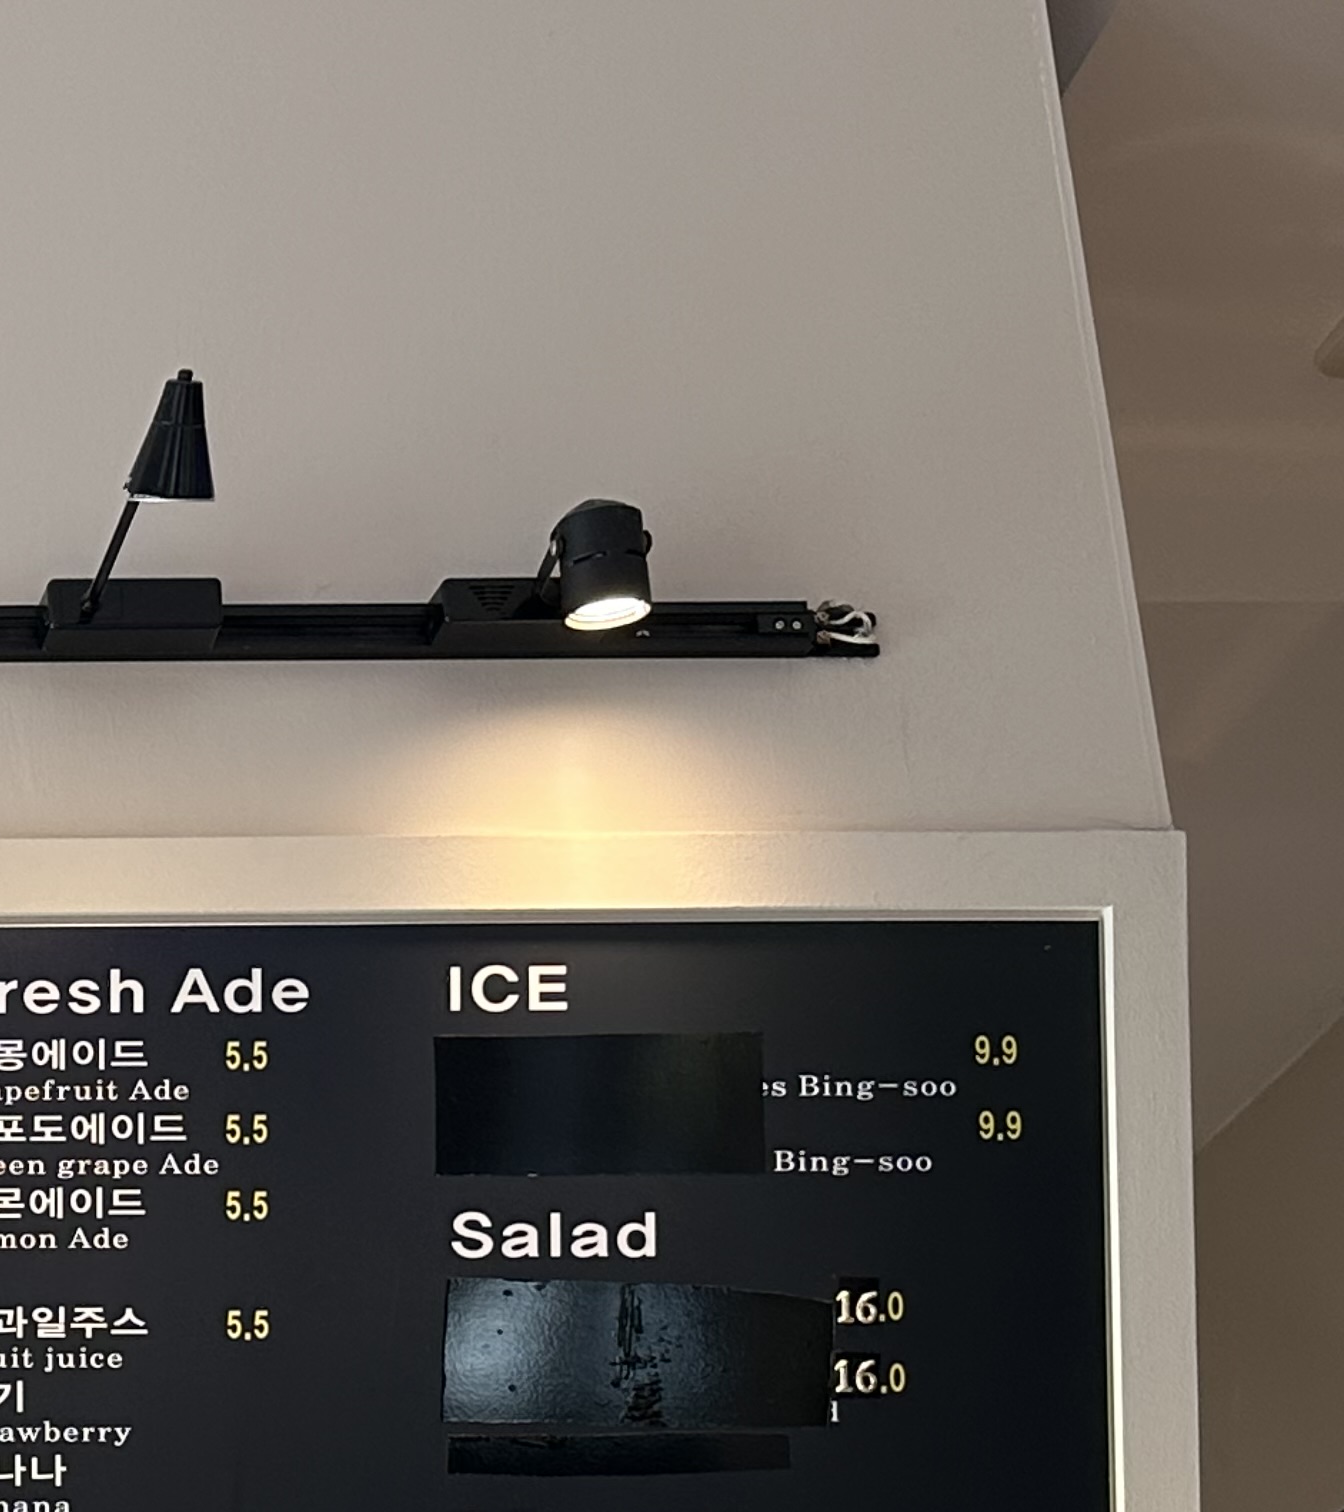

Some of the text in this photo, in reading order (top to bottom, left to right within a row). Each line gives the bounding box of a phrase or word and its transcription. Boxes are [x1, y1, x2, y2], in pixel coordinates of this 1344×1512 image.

[170, 967, 310, 1014] Ade
[449, 964, 569, 1013] ICE
[225, 1040, 268, 1072] 5.5
[974, 1034, 1018, 1066] 9.9
[128, 1078, 190, 1101] Ade
[978, 1110, 1022, 1142] 9.9
[450, 1211, 657, 1259] Salad
[43, 1346, 123, 1373] juice
